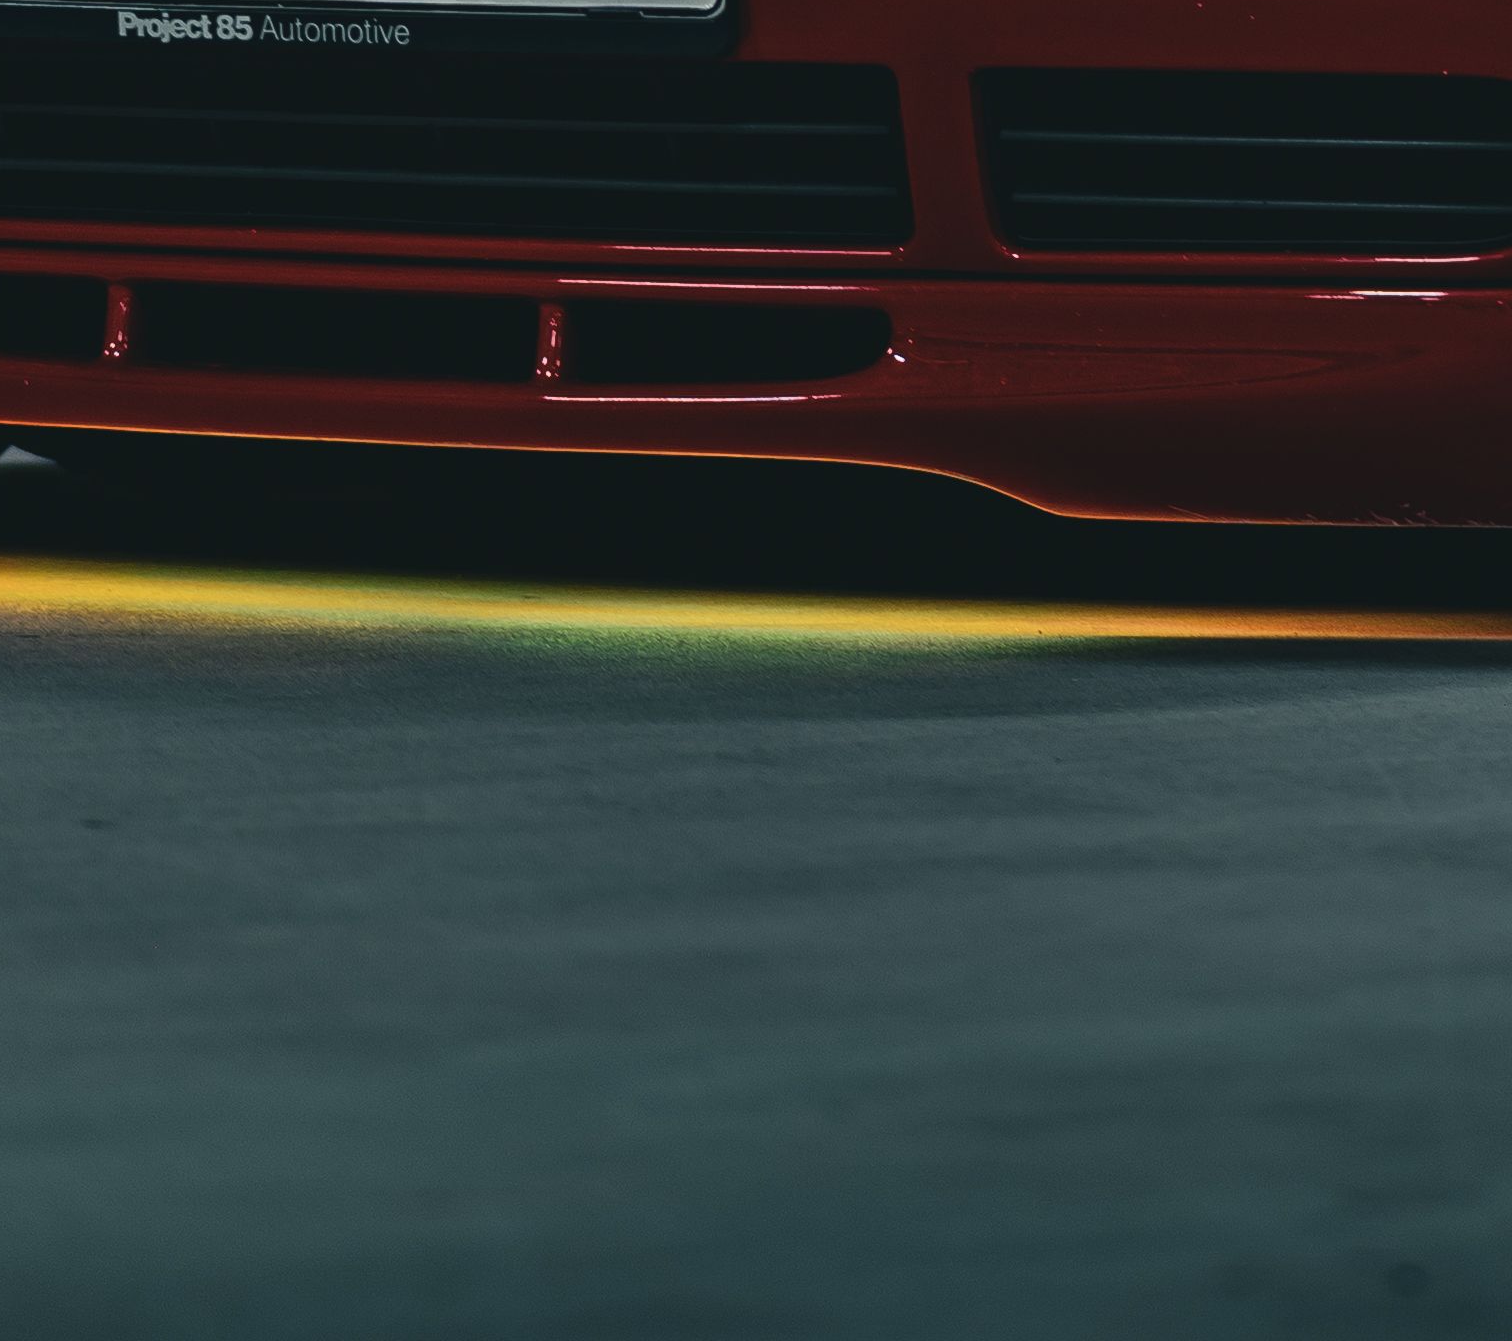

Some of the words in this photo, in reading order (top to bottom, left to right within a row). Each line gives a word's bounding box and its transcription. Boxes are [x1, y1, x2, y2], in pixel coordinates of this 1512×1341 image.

[117, 10, 213, 43] Project
[216, 14, 254, 40] 85
[259, 14, 410, 45] Automotive
